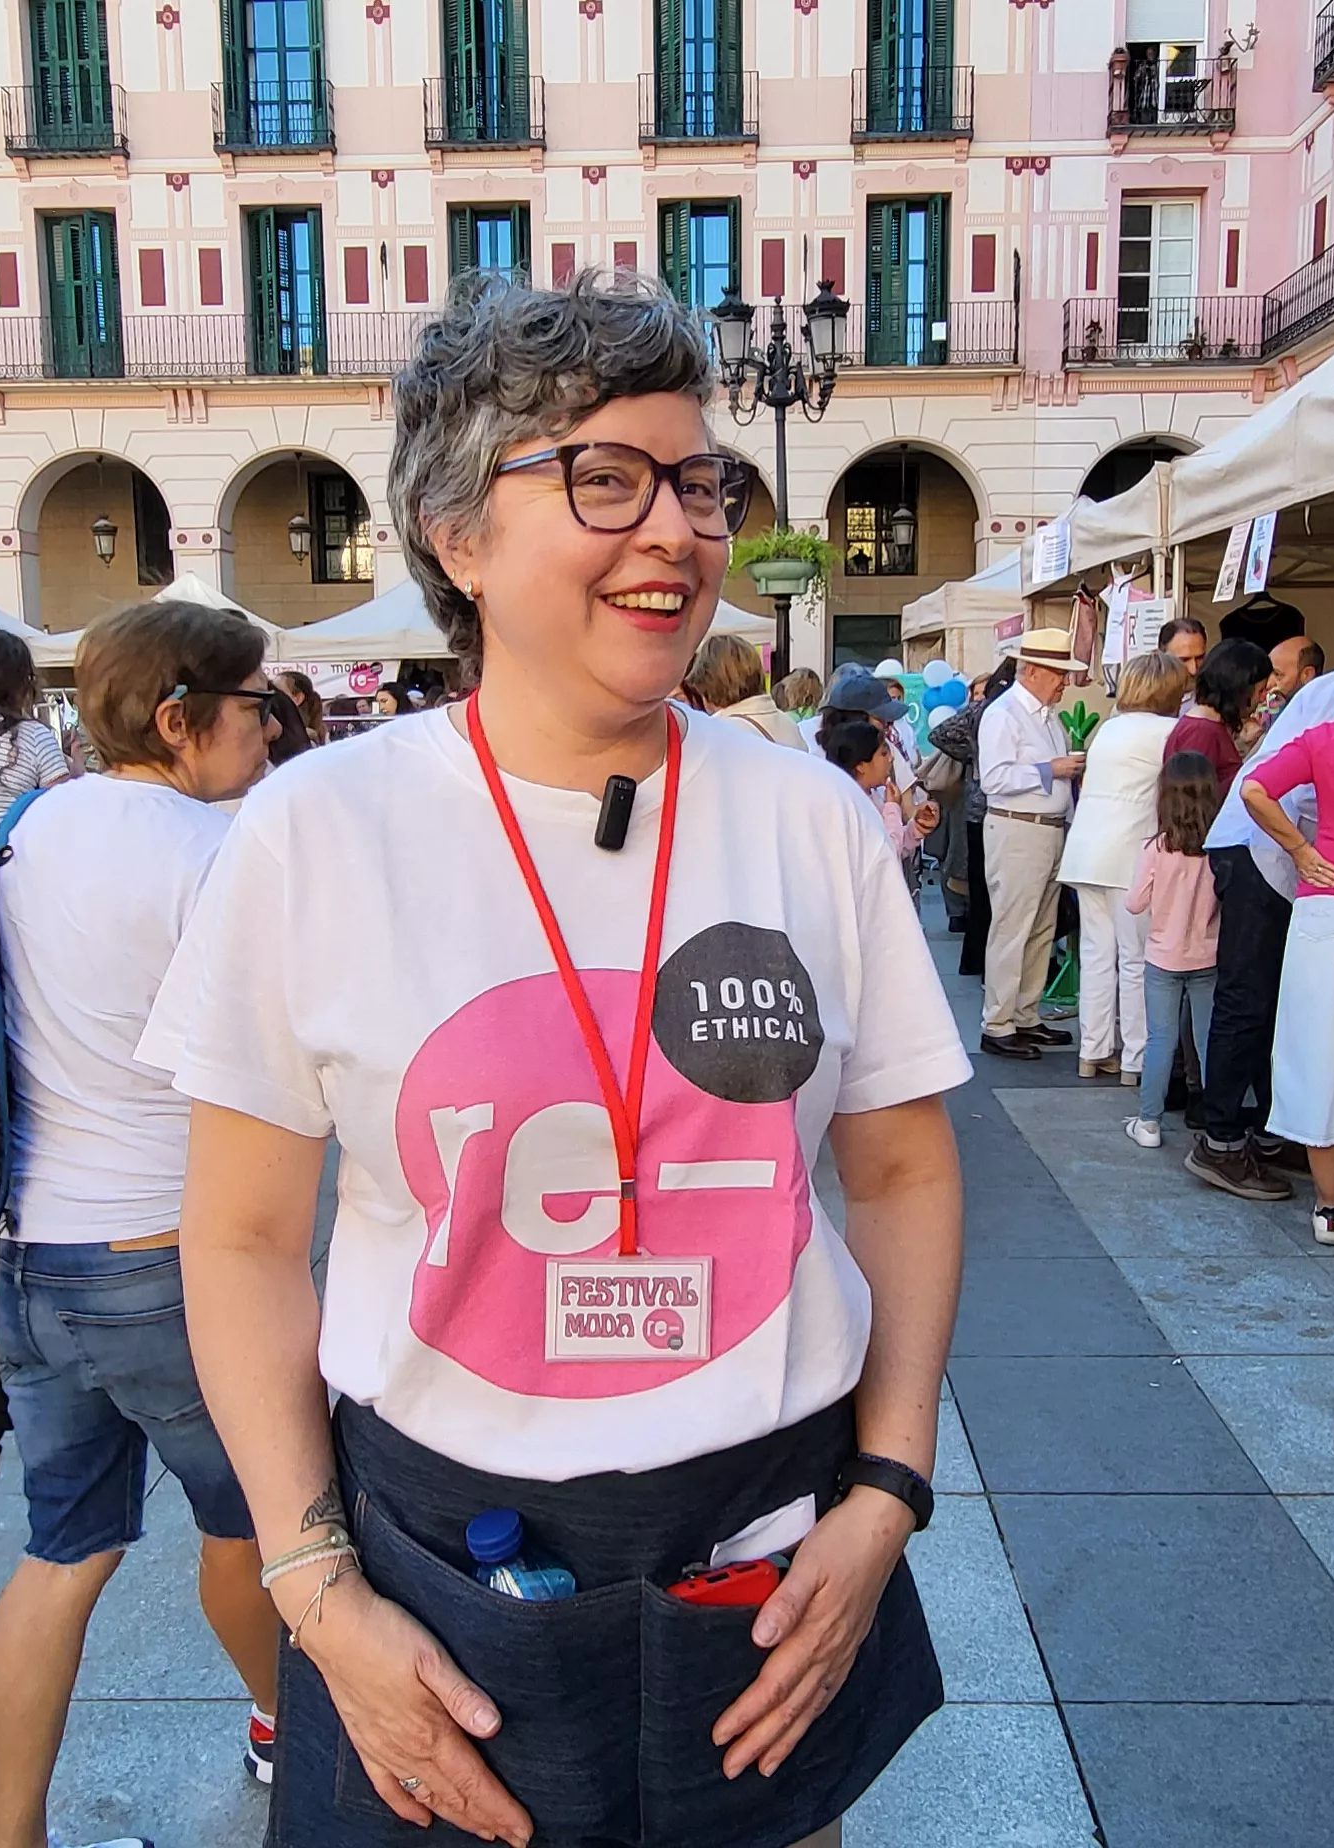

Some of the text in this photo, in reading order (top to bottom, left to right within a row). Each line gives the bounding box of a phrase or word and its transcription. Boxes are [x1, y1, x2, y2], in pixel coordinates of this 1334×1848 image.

[689, 977, 804, 1015] 100%
[690, 1017, 809, 1045] ETHICAL
[560, 1276, 699, 1307] FESTIVAL
[564, 1313, 635, 1338] MODA
